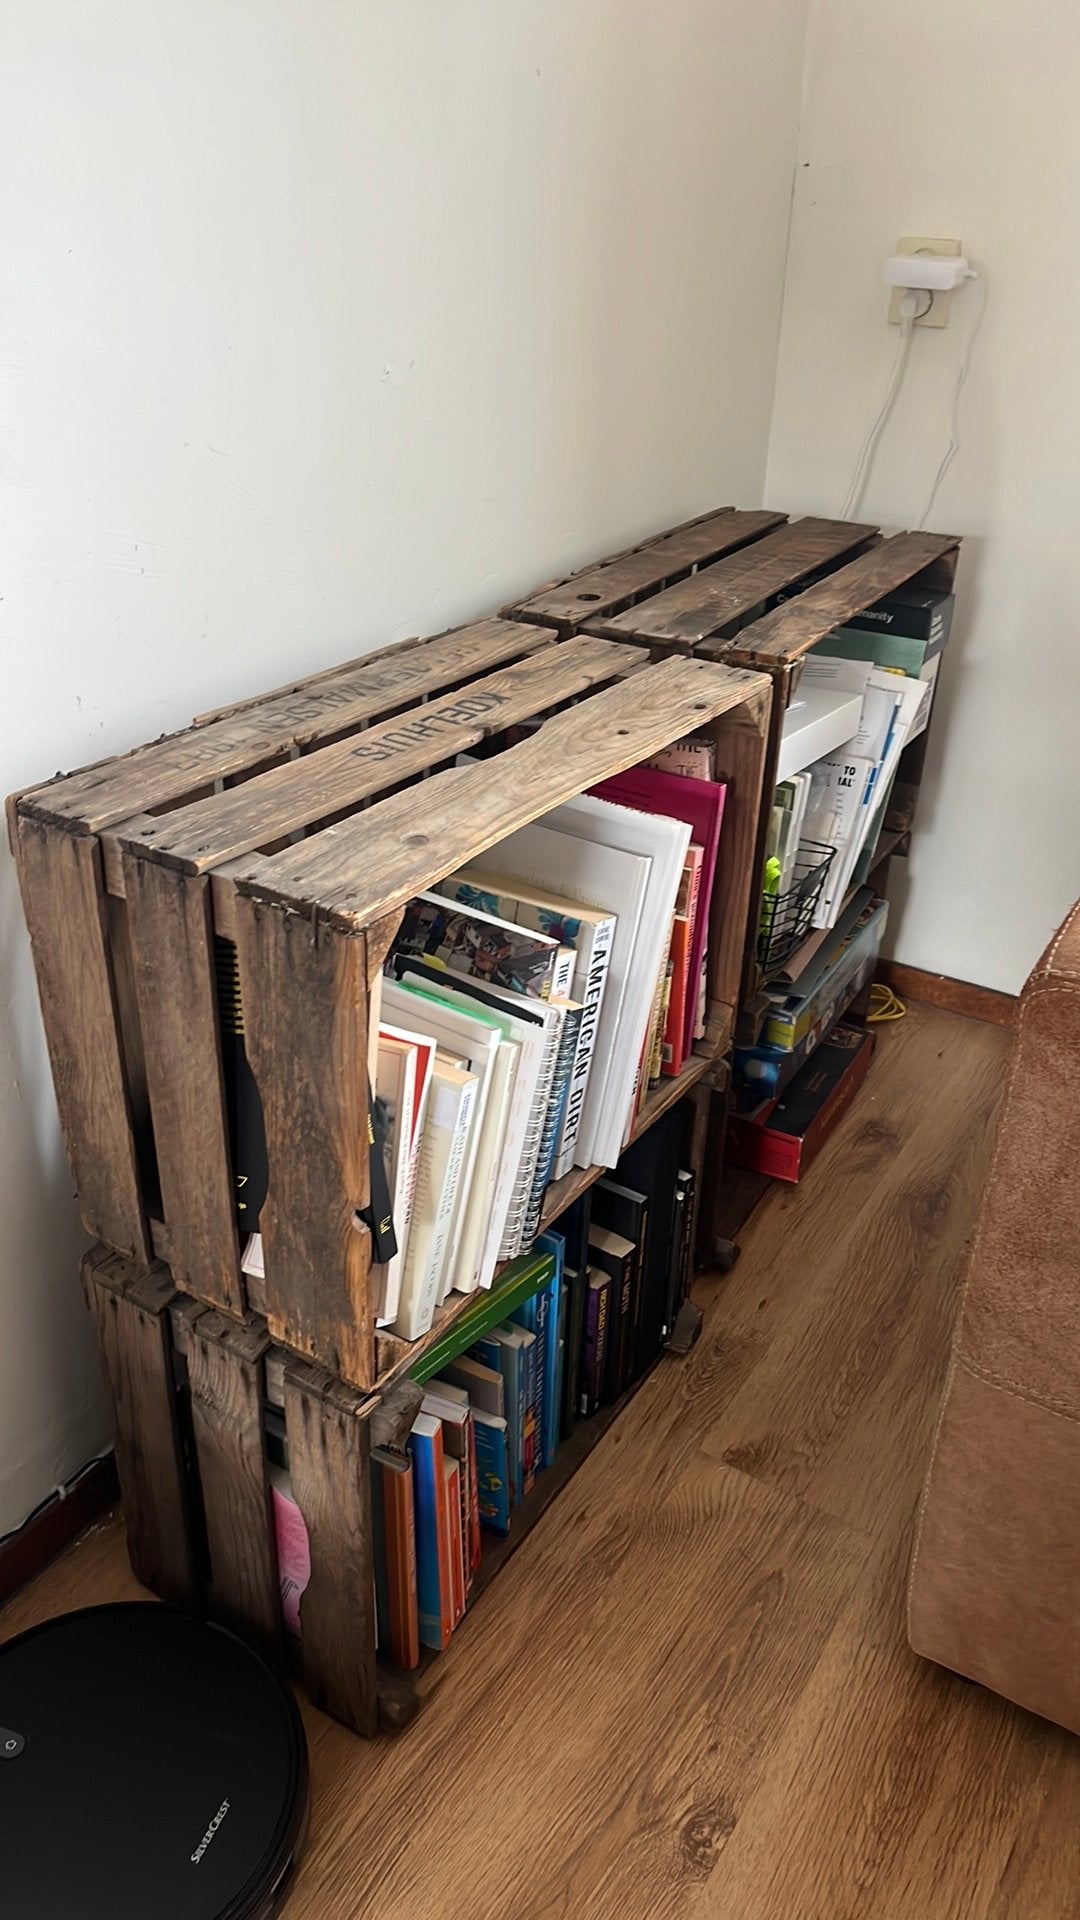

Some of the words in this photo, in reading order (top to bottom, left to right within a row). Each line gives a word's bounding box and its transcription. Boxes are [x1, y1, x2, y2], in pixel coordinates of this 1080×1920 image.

[352, 691, 512, 761] KOELHUIS
[557, 960, 571, 989] THE
[574, 949, 608, 1080] AMERICAN
[563, 1086, 585, 1144] DIRT
